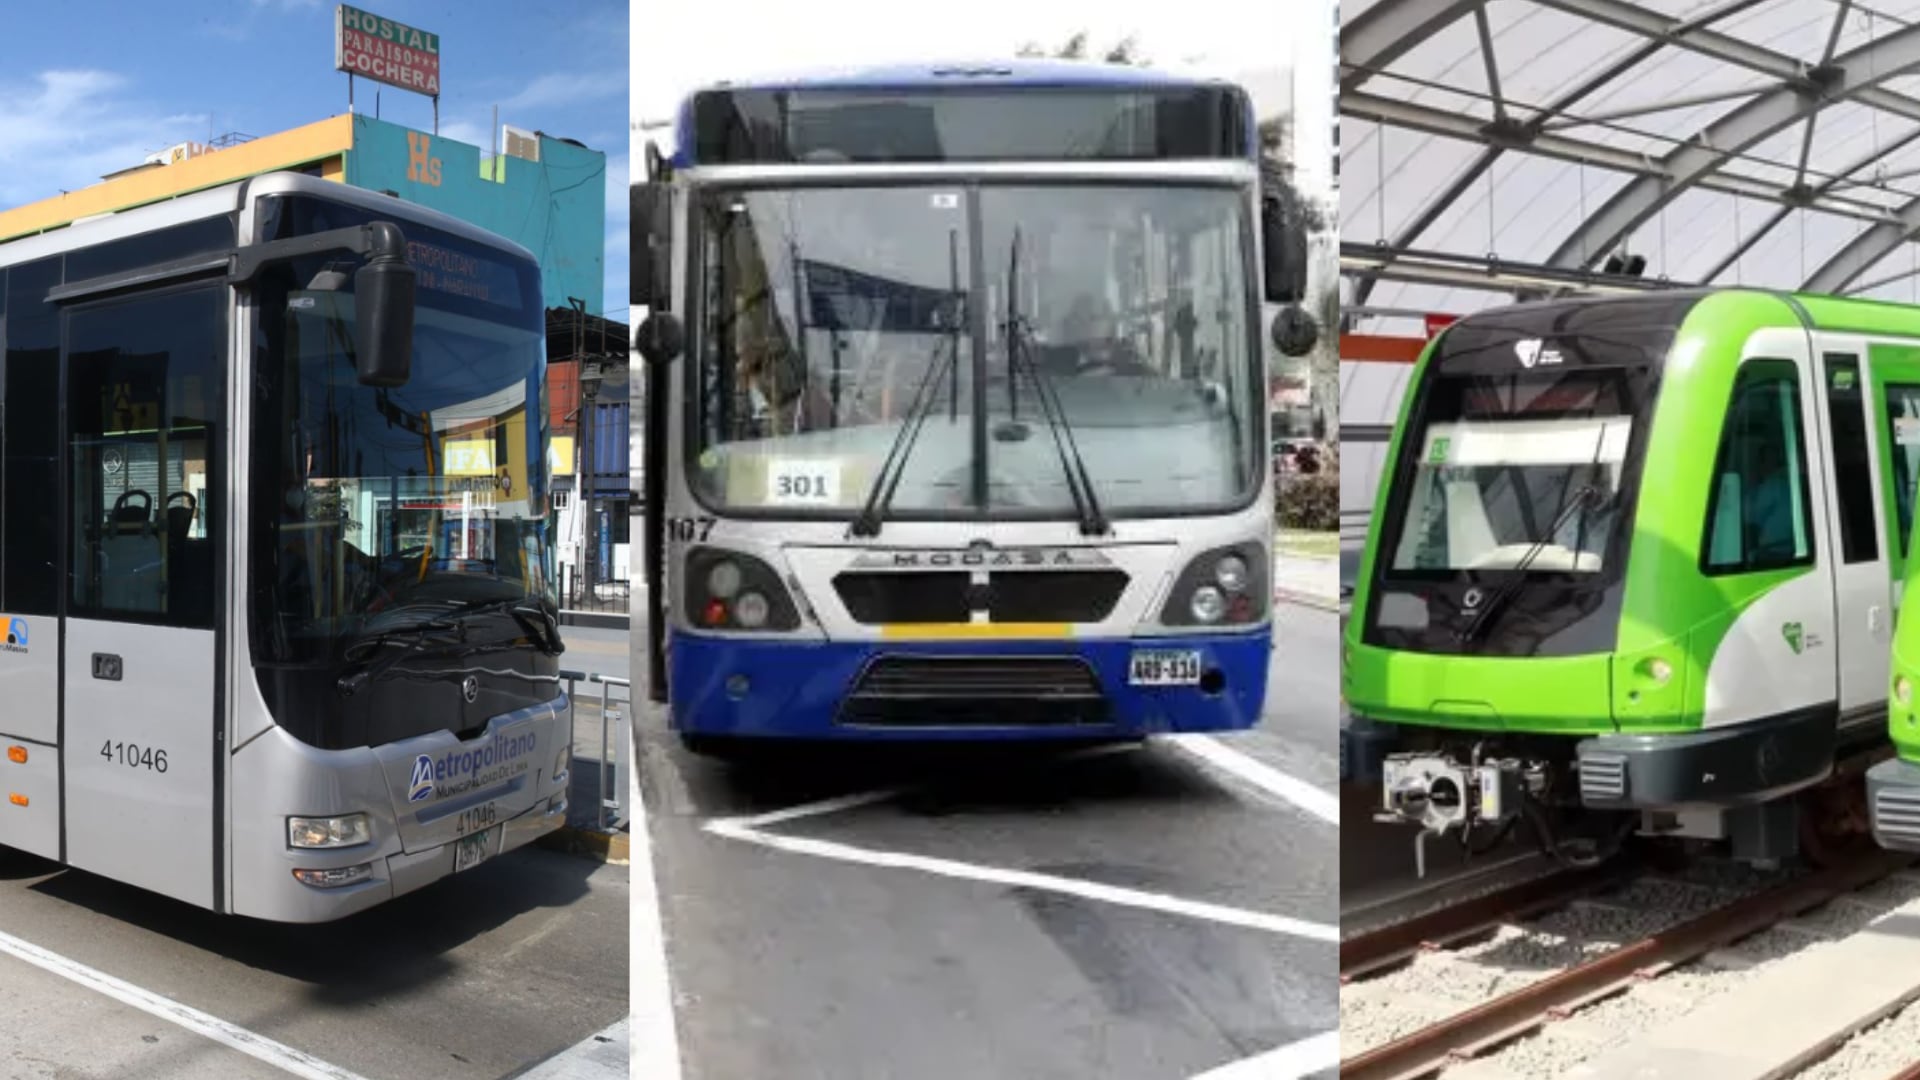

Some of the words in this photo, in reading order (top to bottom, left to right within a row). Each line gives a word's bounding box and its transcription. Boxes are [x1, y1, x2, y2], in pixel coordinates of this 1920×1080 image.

[344, 7, 437, 54] HOSTAL
[343, 49, 438, 92] COCHERA
[777, 475, 828, 497] 301
[894, 552, 1074, 566] MODASA
[100, 739, 168, 774] 41046
[410, 732, 536, 798] Metropolitano
[456, 801, 496, 836] 41046
